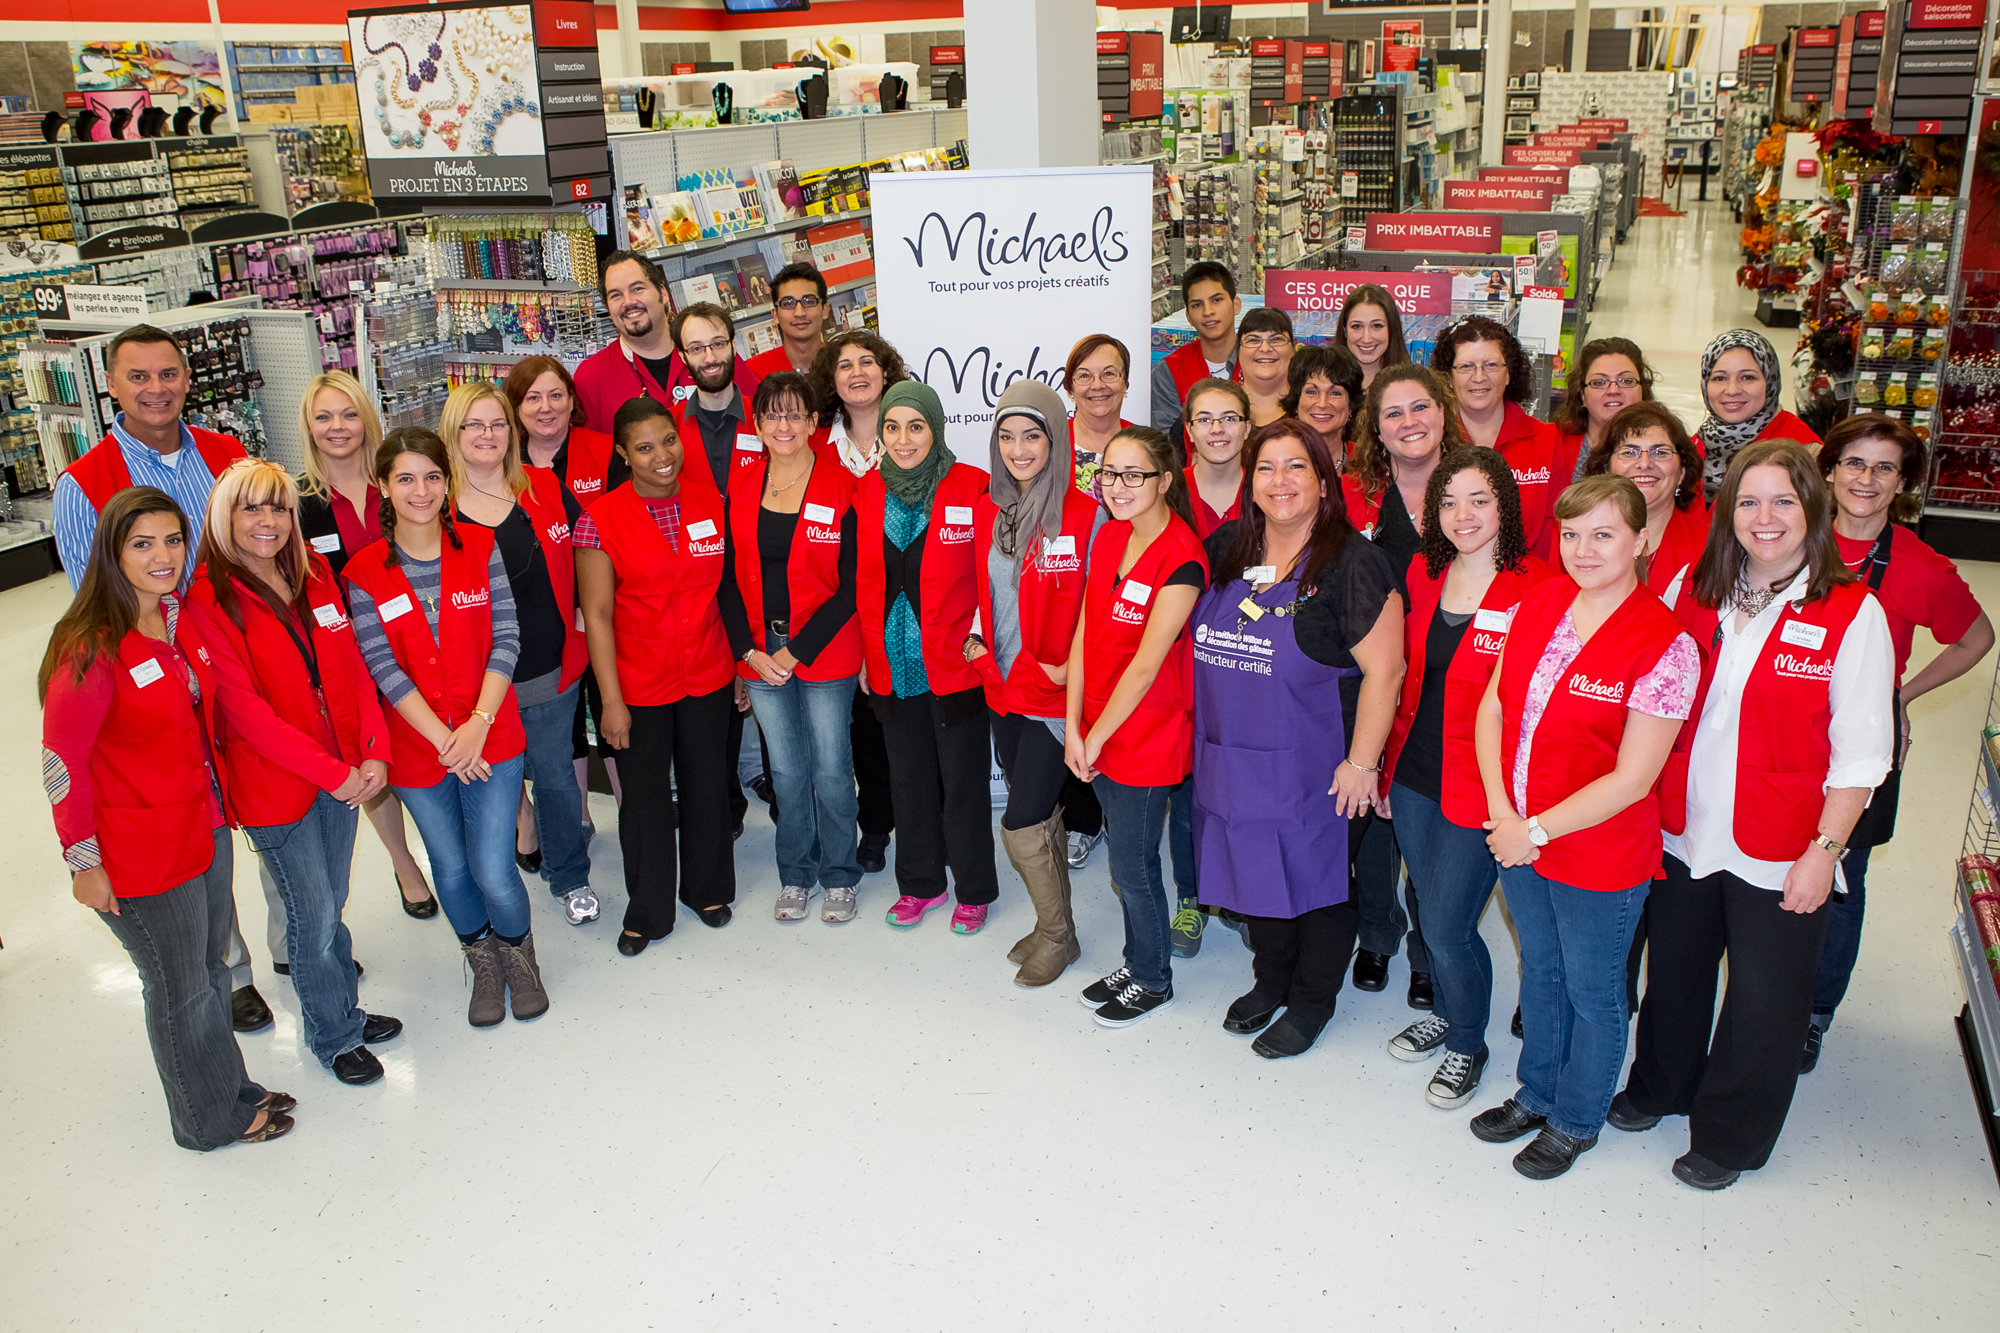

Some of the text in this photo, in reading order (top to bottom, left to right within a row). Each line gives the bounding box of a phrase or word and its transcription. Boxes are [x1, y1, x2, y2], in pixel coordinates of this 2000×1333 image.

[1925, 4, 1972, 12] Décoration
[1924, 12, 1972, 20] saisonnière
[556, 19, 578, 29] Livres
[554, 62, 585, 71] Instruction
[1142, 63, 1155, 76] PRIX
[1131, 78, 1162, 91] IMBATTABLE
[548, 95, 574, 104] Artisanat
[582, 94, 597, 102] idées
[1925, 123, 1933, 132] 7
[11, 154, 51, 164] élégantes
[434, 160, 476, 176] Michaels
[770, 167, 795, 181] TRICOT
[389, 174, 528, 192] PROJET EN 3 ÉTAPES
[575, 184, 587, 196] 82
[739, 189, 759, 208] ULTI
[1452, 188, 1544, 199] PRIX IMBATTABLE
[744, 207, 763, 221] IGAMI
[1376, 224, 1491, 237] PRIX IMBATTABLE
[122, 234, 164, 246] Breloques
[784, 239, 808, 253] TRICOT
[840, 236, 866, 250] COUTURE
[903, 206, 1128, 276] Michaels
[814, 242, 840, 256] COUTURE
[928, 274, 1109, 294] Tout pour vos projets créatifs
[1284, 282, 1431, 298] CES CHO QUE
[35, 288, 62, 311] 99¢
[67, 292, 101, 301] mélangez
[112, 294, 142, 302] agencez
[1529, 288, 1558, 299] Solde
[74, 303, 84, 312] les
[86, 304, 108, 314] perles
[1297, 297, 1343, 310] NOUS
[1164, 332, 1200, 342] Rainbo
[908, 346, 1072, 408] Micha
[944, 412, 994, 426] out pour
[573, 477, 601, 491] Michae
[806, 526, 841, 540] Michae
[939, 527, 974, 541] Michaels
[688, 538, 725, 553] Michael
[1112, 601, 1144, 620] Micha
[1208, 628, 1272, 647] La méthode Wilton de
[1788, 624, 1821, 638] Michaels
[1207, 636, 1274, 656] décoration des gâteaux
[1474, 633, 1504, 650] Mich
[1194, 647, 1272, 676] Instructeur certifié
[1774, 653, 1833, 676] Michaels
[1569, 673, 1624, 698] Michaels
[990, 773, 1005, 781] ur
